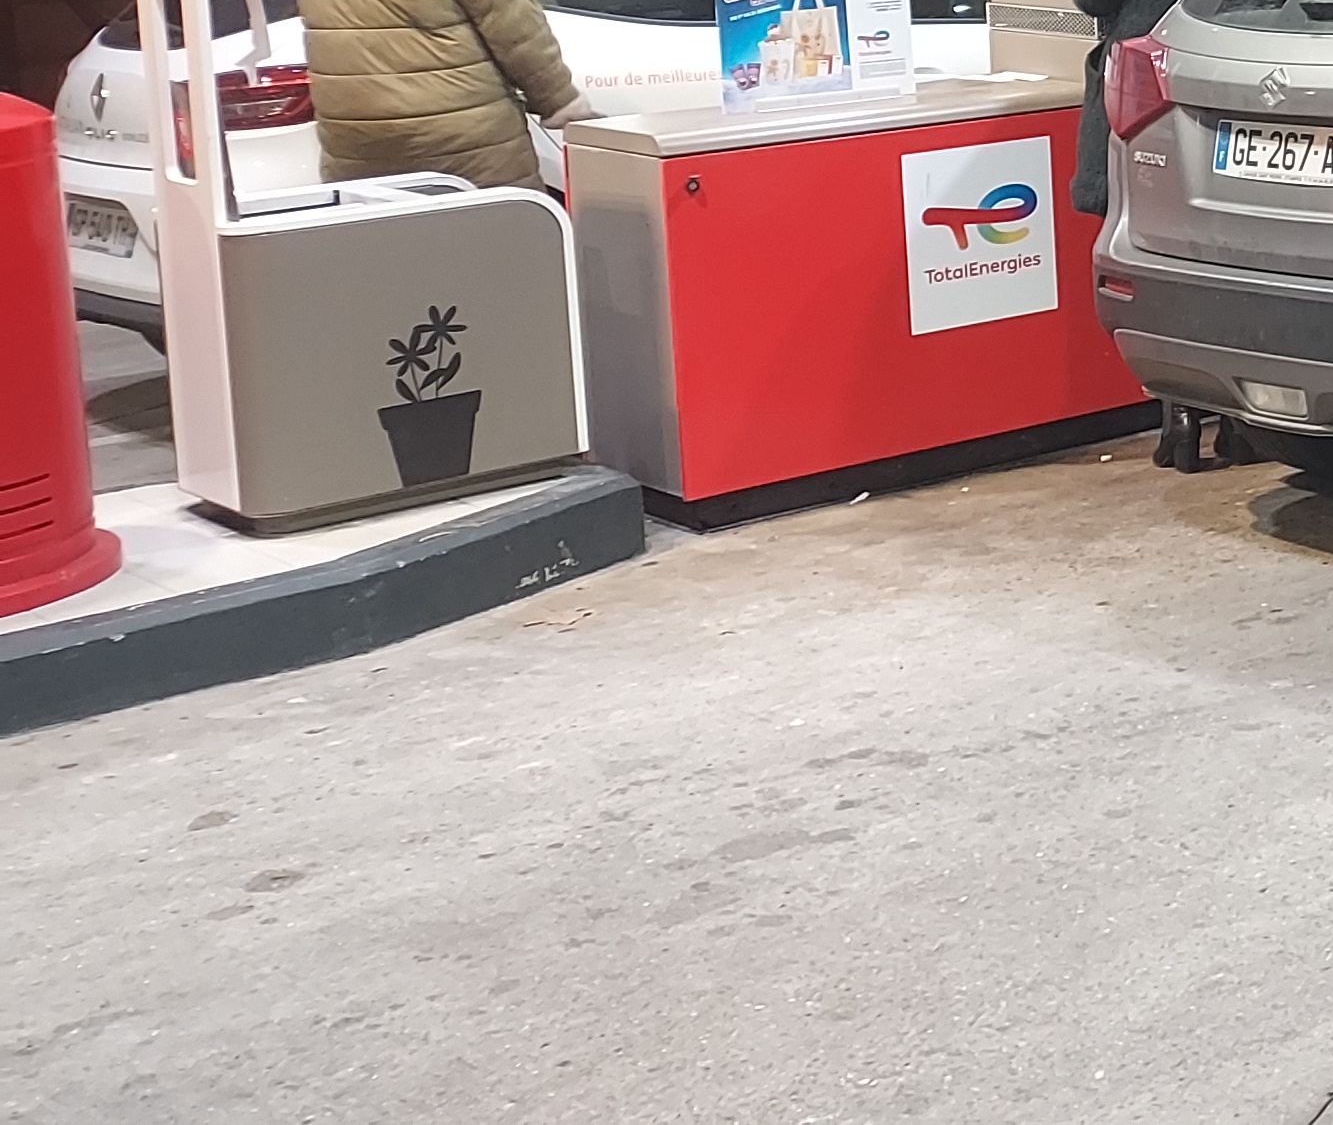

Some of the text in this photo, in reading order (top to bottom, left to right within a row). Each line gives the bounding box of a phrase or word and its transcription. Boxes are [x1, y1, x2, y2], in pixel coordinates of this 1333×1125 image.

[585, 75, 618, 88] Pour
[624, 72, 644, 86] de
[924, 254, 1042, 284] TotalEnergies
